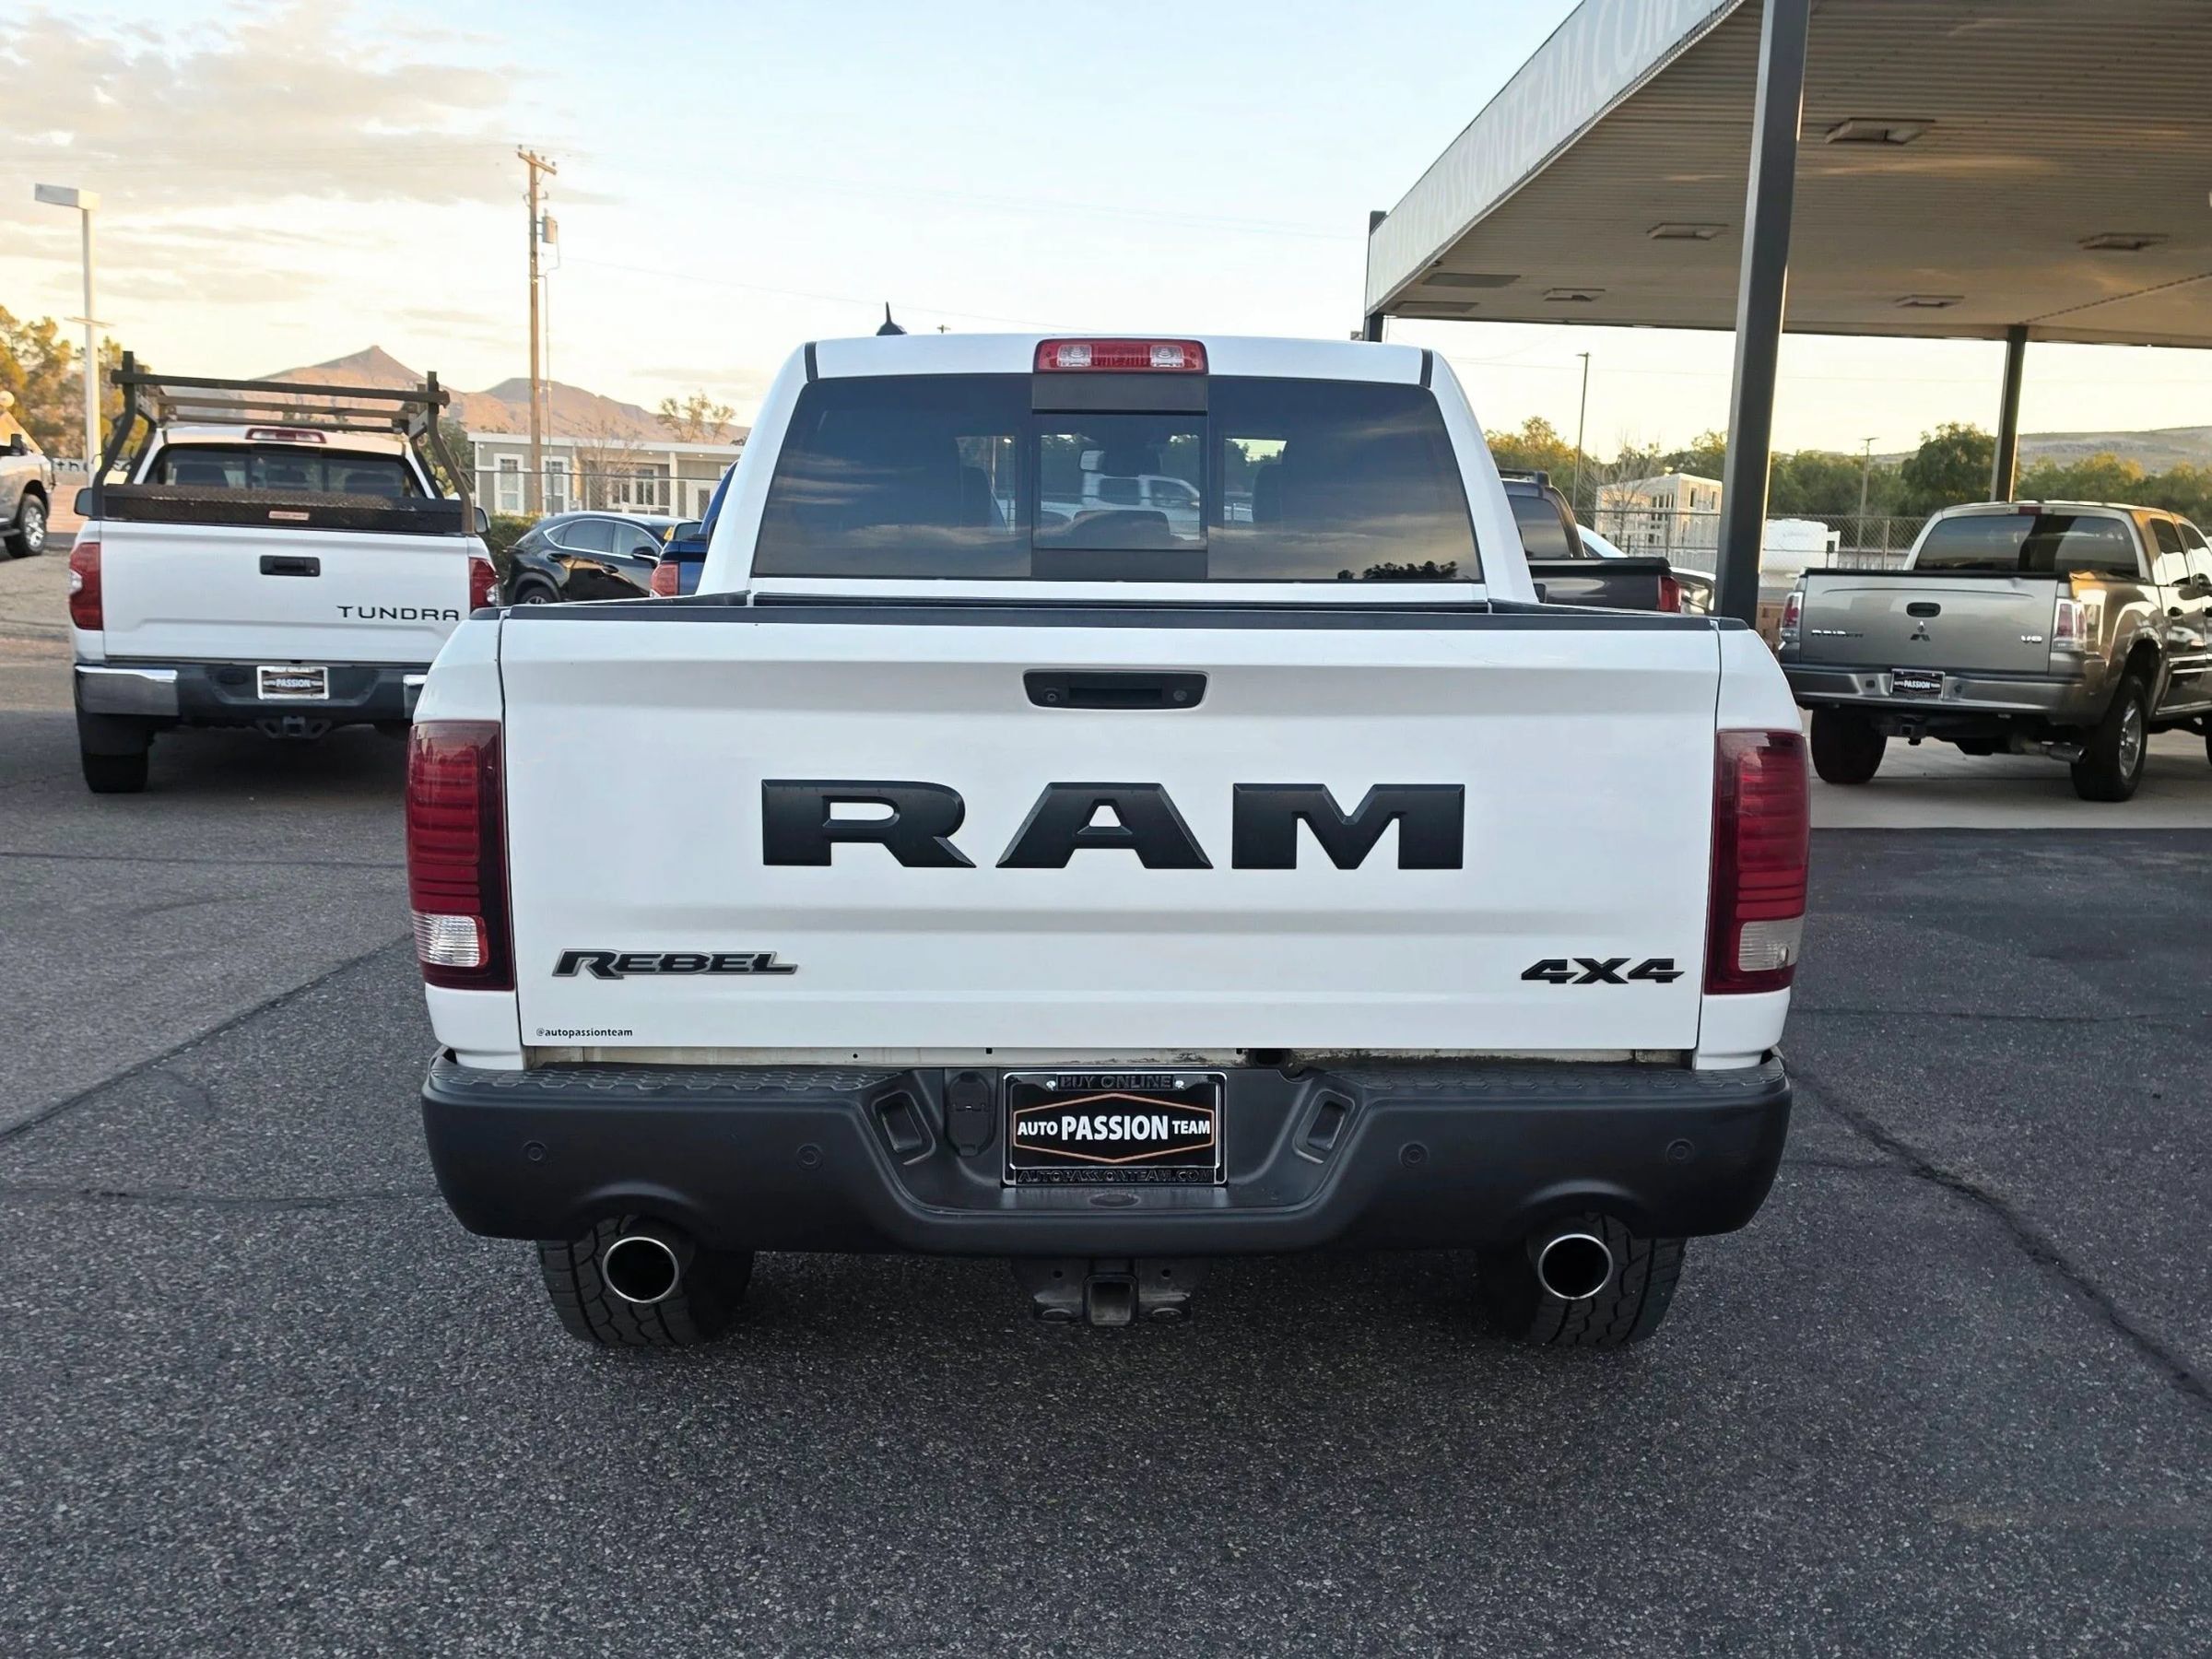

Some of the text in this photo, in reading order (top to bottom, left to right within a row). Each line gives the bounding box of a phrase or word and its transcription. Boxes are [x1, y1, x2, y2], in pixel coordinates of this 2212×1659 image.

[336, 606, 459, 621] TUNDRA
[276, 678, 312, 688] PASSION
[1903, 679, 1931, 688] PASSION
[761, 778, 1465, 870] RAM
[552, 948, 798, 980] REBEL
[1521, 958, 1686, 983] 4X4
[535, 1028, 633, 1039] @autopassionteam
[1060, 1076, 1172, 1088] BUY ONLINE
[1018, 1115, 1210, 1141] AUTO PASSION TEAM
[1018, 1169, 1213, 1183] AUTOPASSIONTEAM.COM
